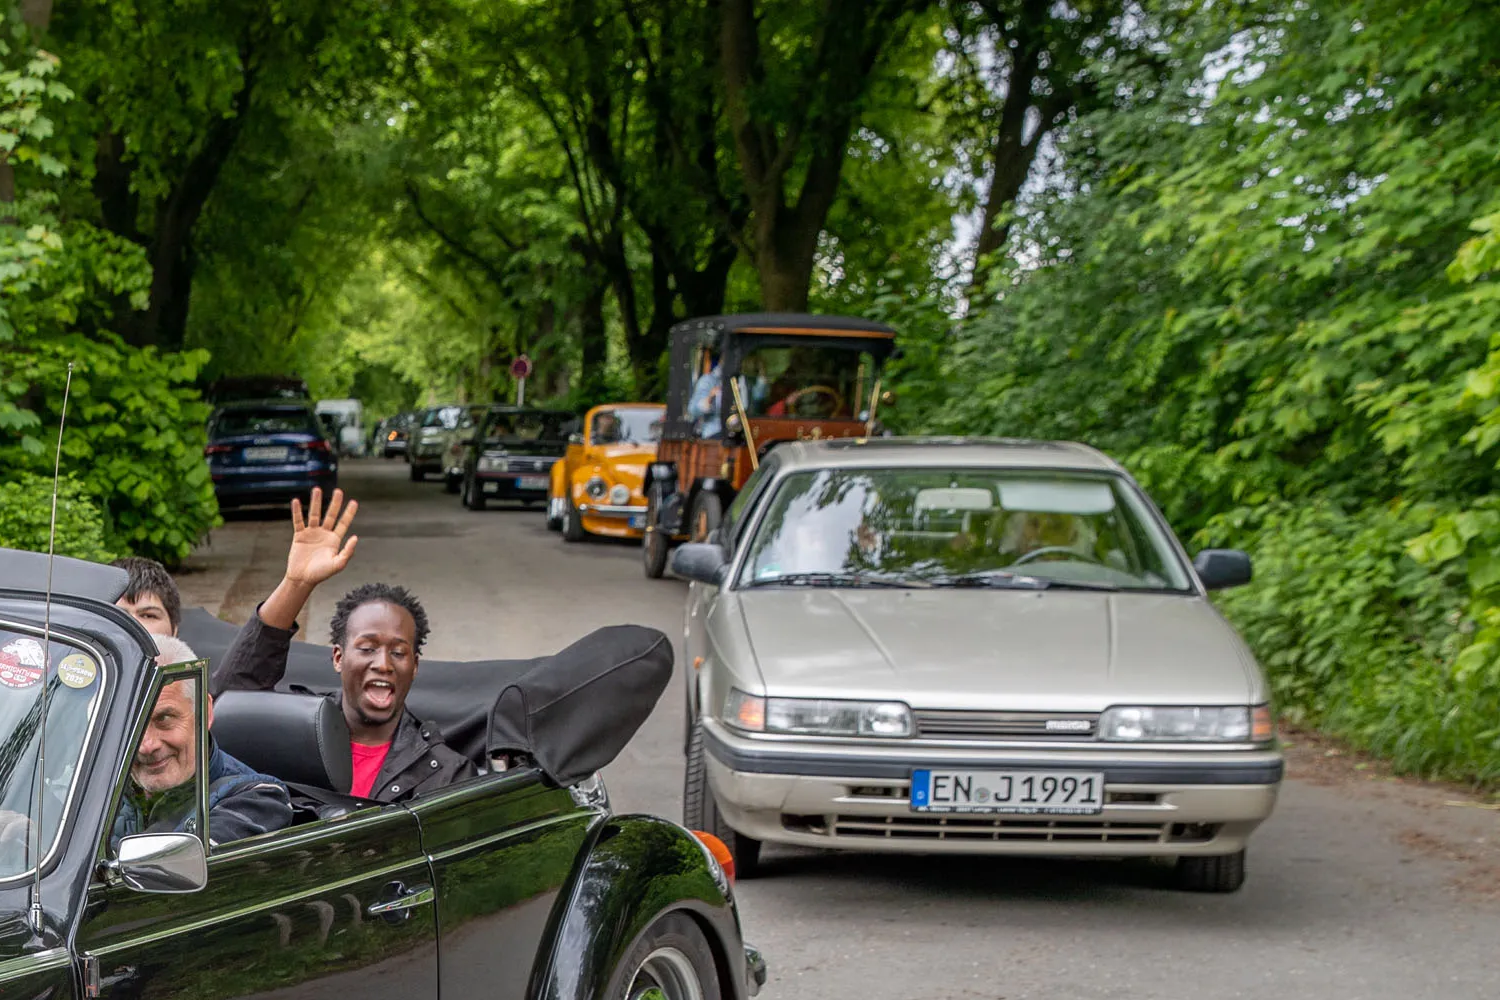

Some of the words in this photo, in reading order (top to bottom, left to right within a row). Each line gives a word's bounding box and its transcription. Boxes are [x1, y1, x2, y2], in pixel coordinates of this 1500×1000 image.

[933, 775, 972, 802] EN
[994, 776, 1014, 802] J
[1020, 776, 1097, 803] 1991
